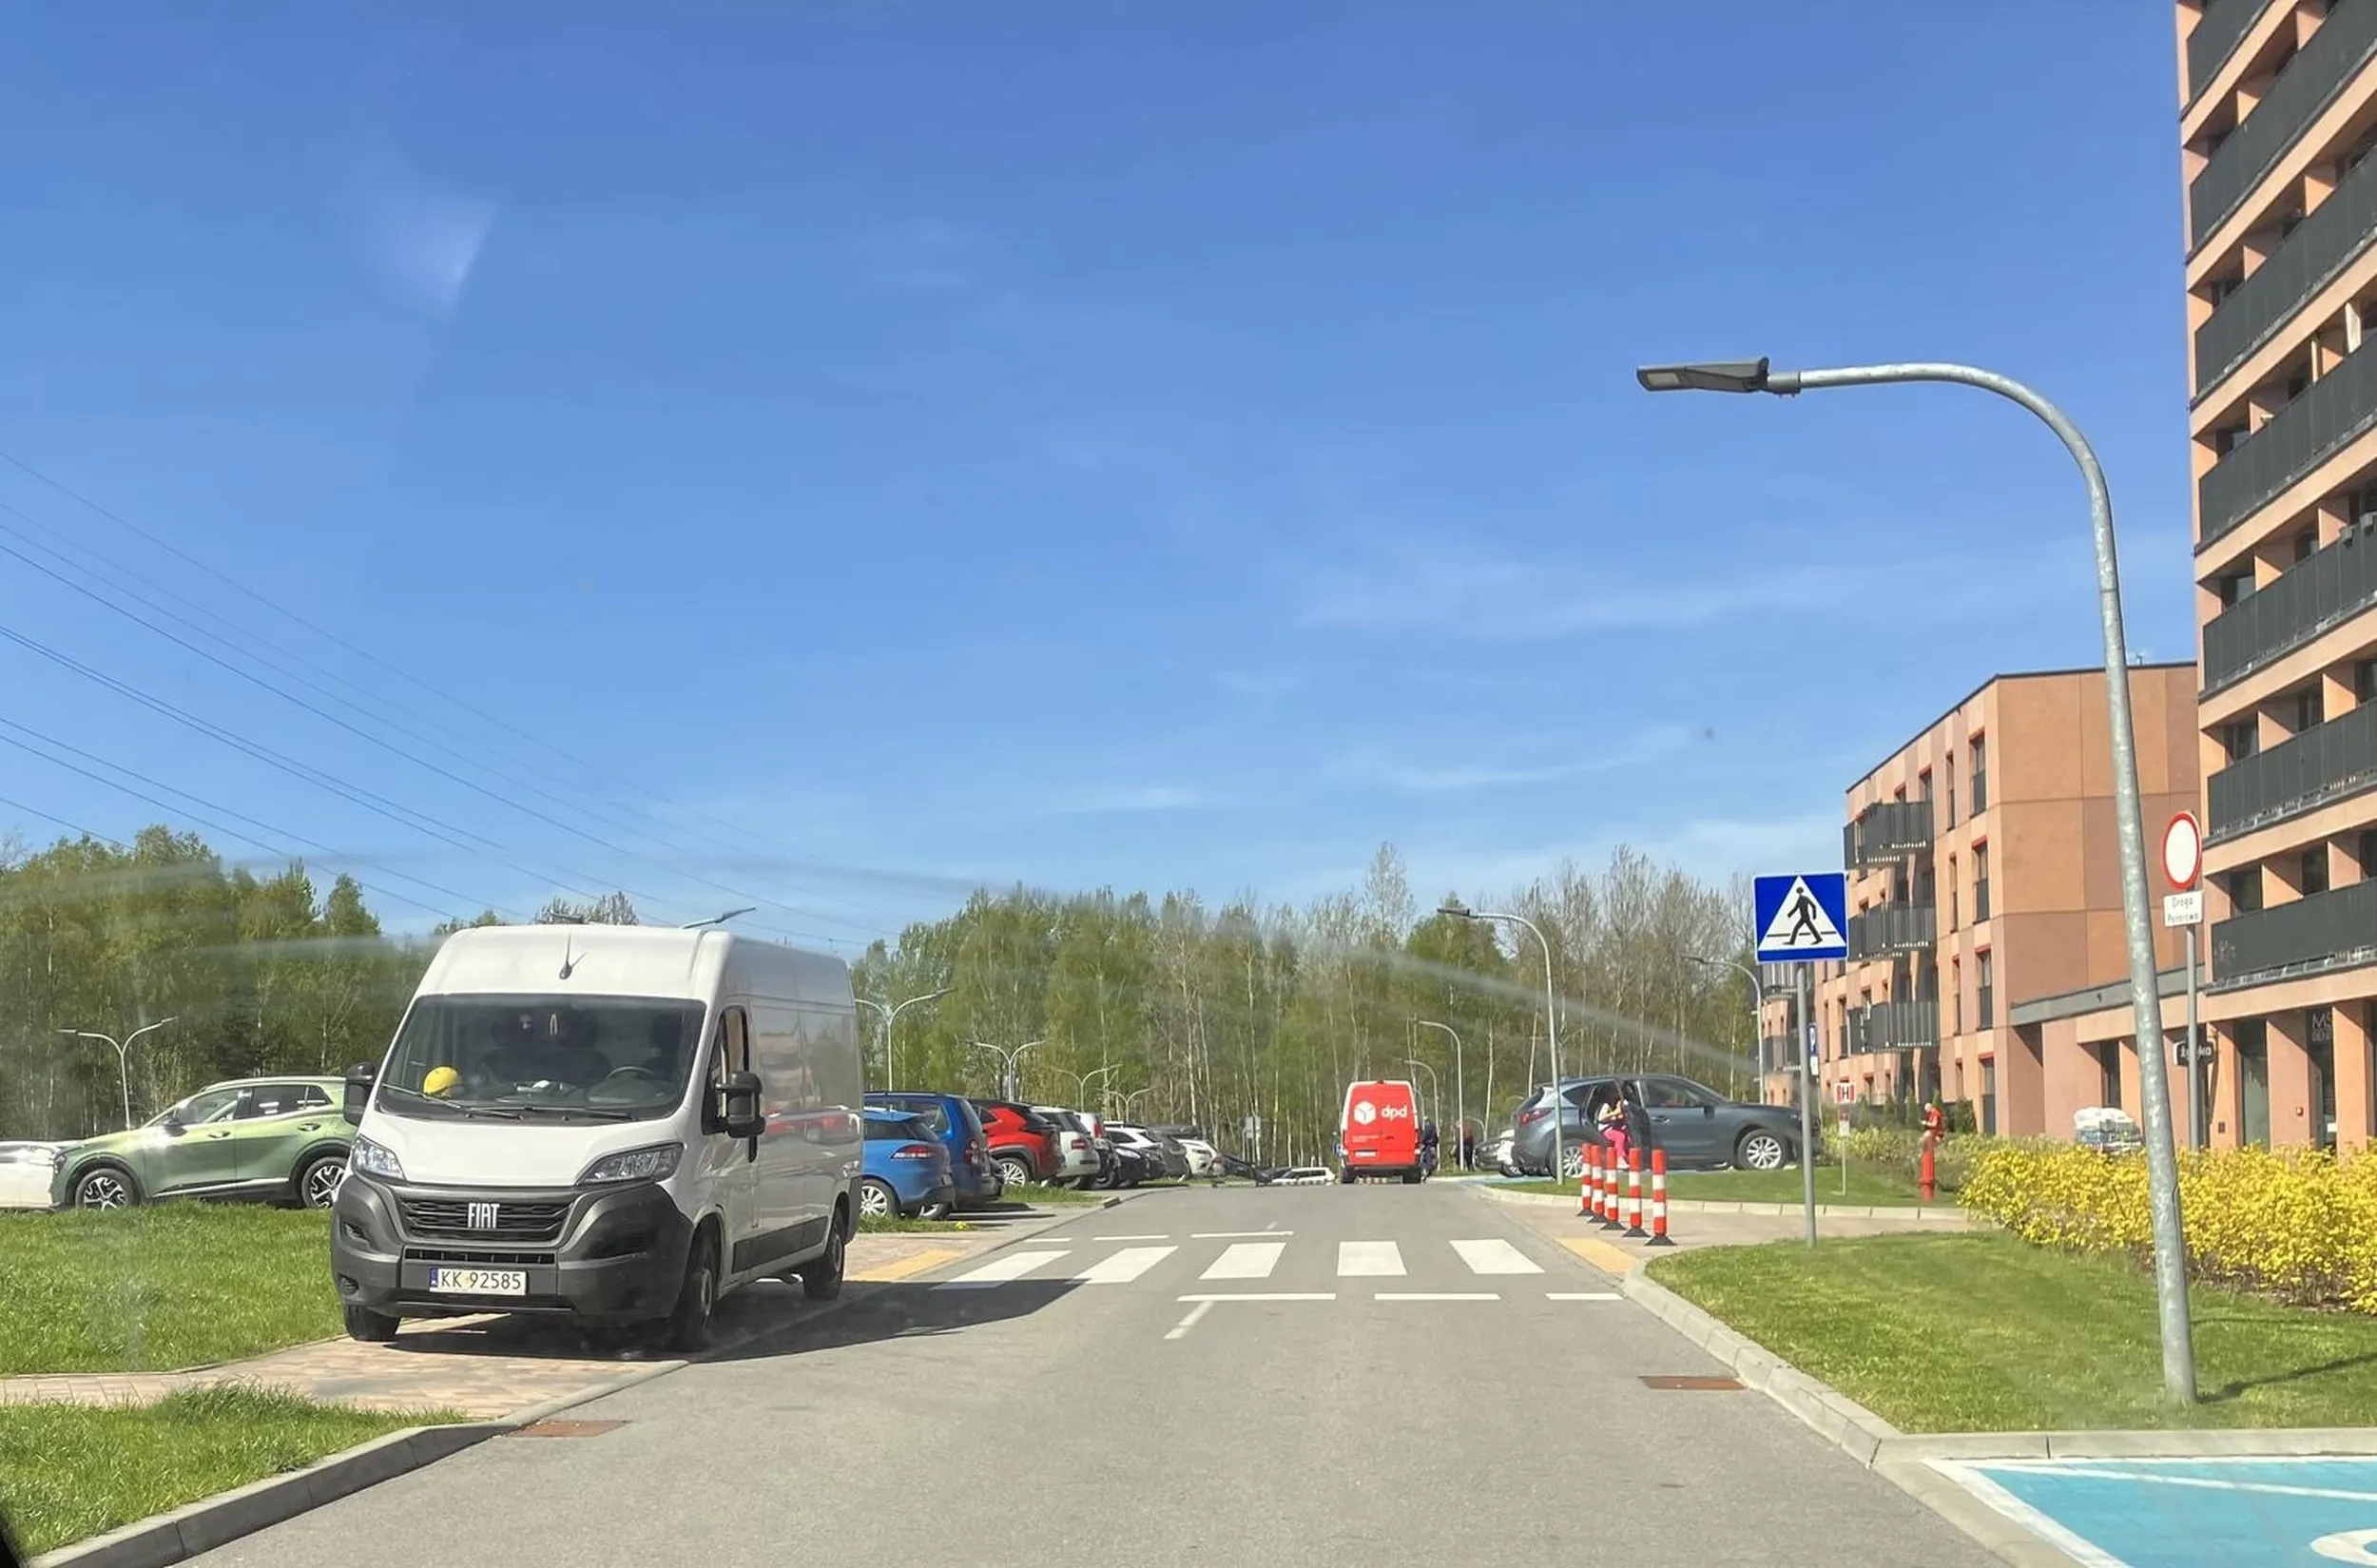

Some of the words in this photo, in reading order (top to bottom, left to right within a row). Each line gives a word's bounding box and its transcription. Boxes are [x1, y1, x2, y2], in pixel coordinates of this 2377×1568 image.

[1381, 1104, 1408, 1122] dpd
[467, 1203, 500, 1229] FIAT
[441, 1270, 462, 1288] KK
[469, 1271, 521, 1290] 92585
